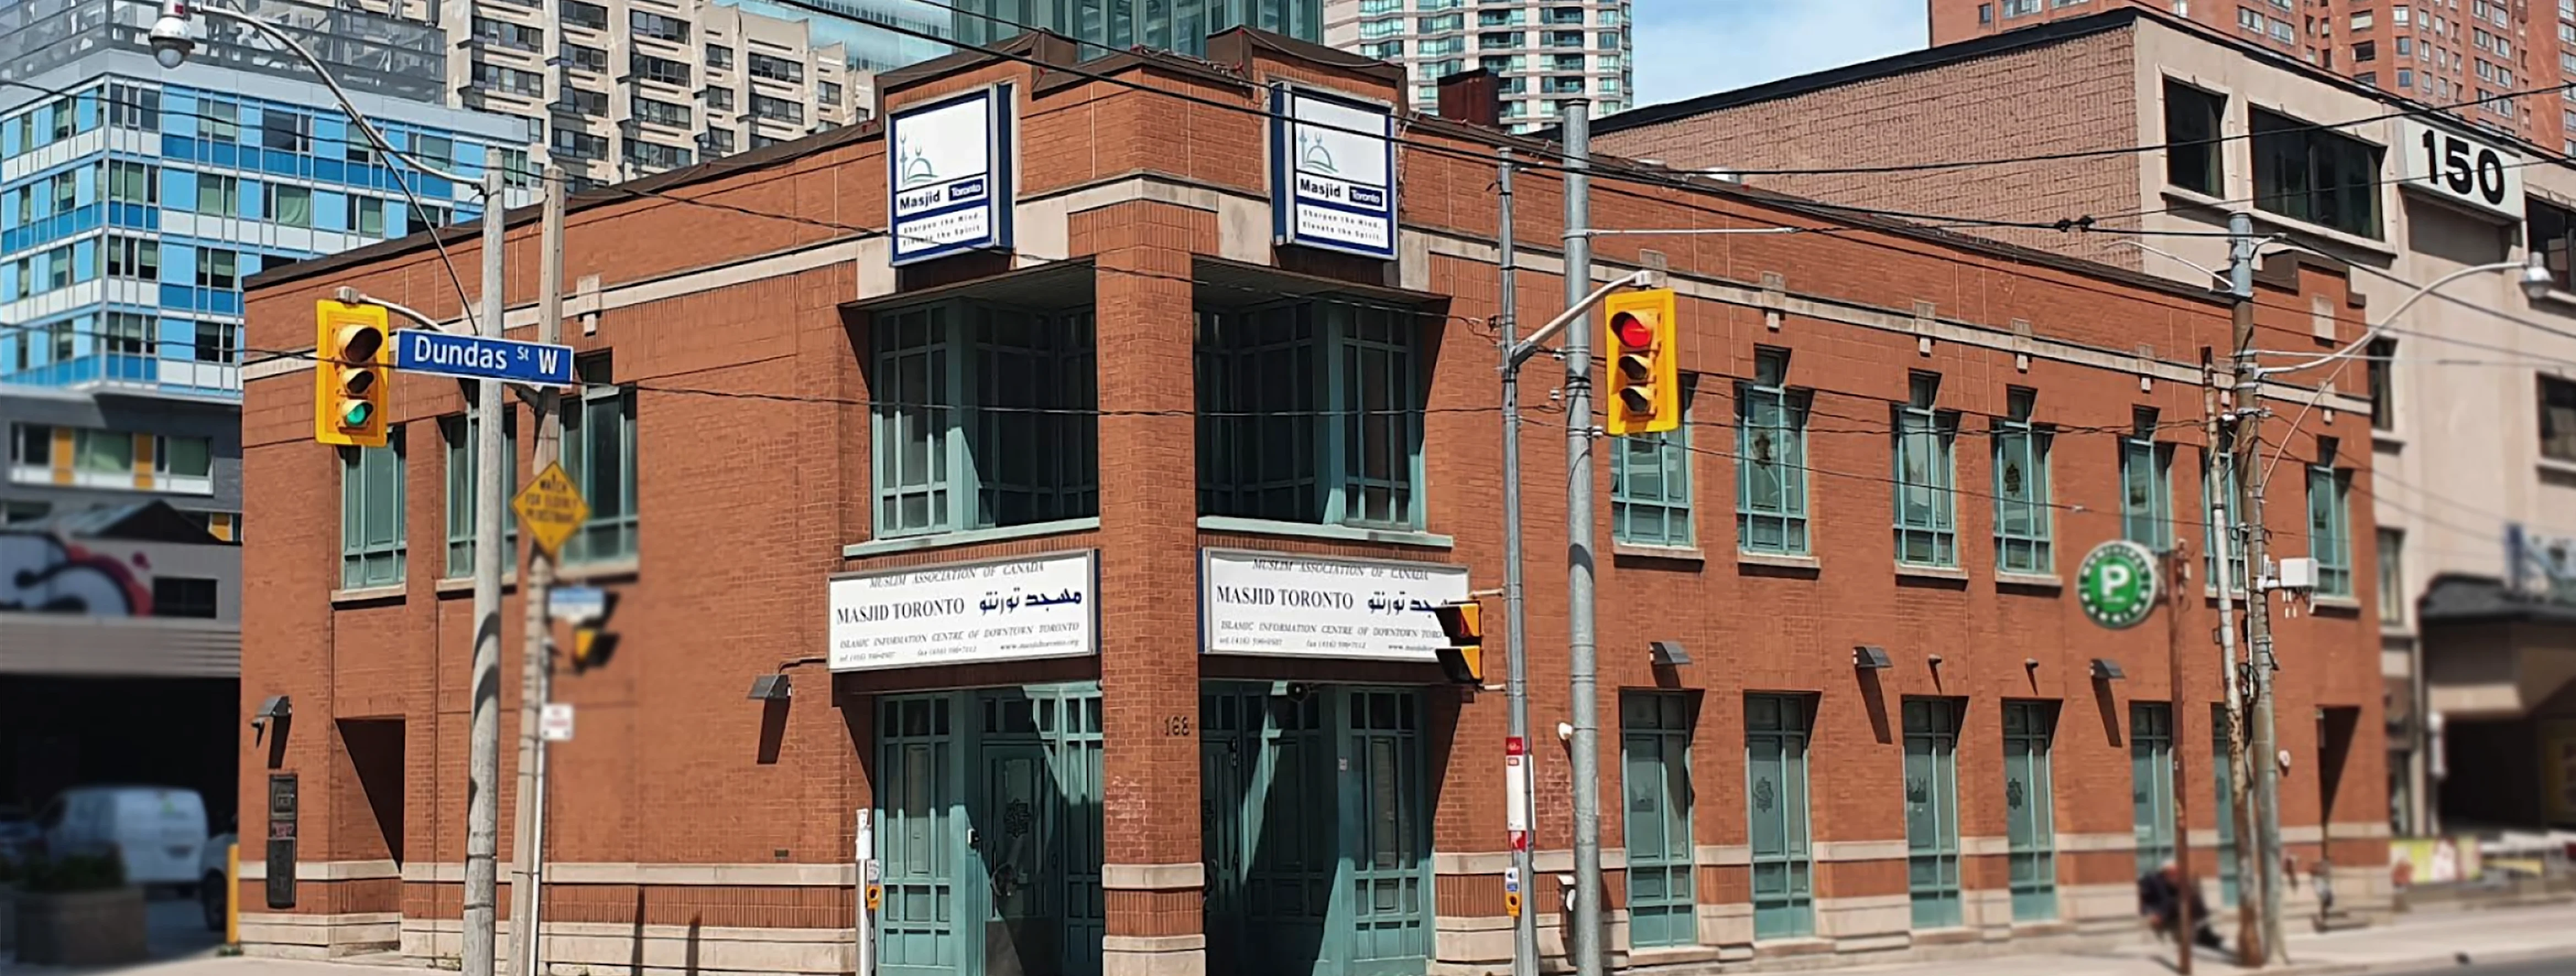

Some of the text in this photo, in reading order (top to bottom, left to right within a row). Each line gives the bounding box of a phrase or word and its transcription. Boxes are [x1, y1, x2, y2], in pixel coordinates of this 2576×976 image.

[2422, 129, 2504, 205] 150
[900, 184, 981, 210] Masjid Toronto
[1300, 178, 1380, 204] Masjid Toronto
[415, 335, 558, 375] Dundas St W
[983, 566, 996, 578] OF
[1252, 559, 1293, 572] MUSLIM
[1371, 566, 1383, 578] OF
[2101, 564, 2130, 595] P
[979, 587, 1082, 616] مسجد تورنتو
[1216, 585, 1354, 610] MASJID TORONTO
[1368, 591, 1405, 615] تورنتو
[837, 598, 965, 625] MASJID TORONTO
[931, 631, 964, 643] CENTRE
[968, 630, 980, 639] OF
[1039, 621, 1080, 633] TORONTO
[1259, 622, 1317, 633] INFORMATION
[1322, 625, 1354, 635] CENTRE
[1357, 626, 1369, 635] OF
[1421, 630, 1443, 639] TORO
[1164, 716, 1189, 736] 168
